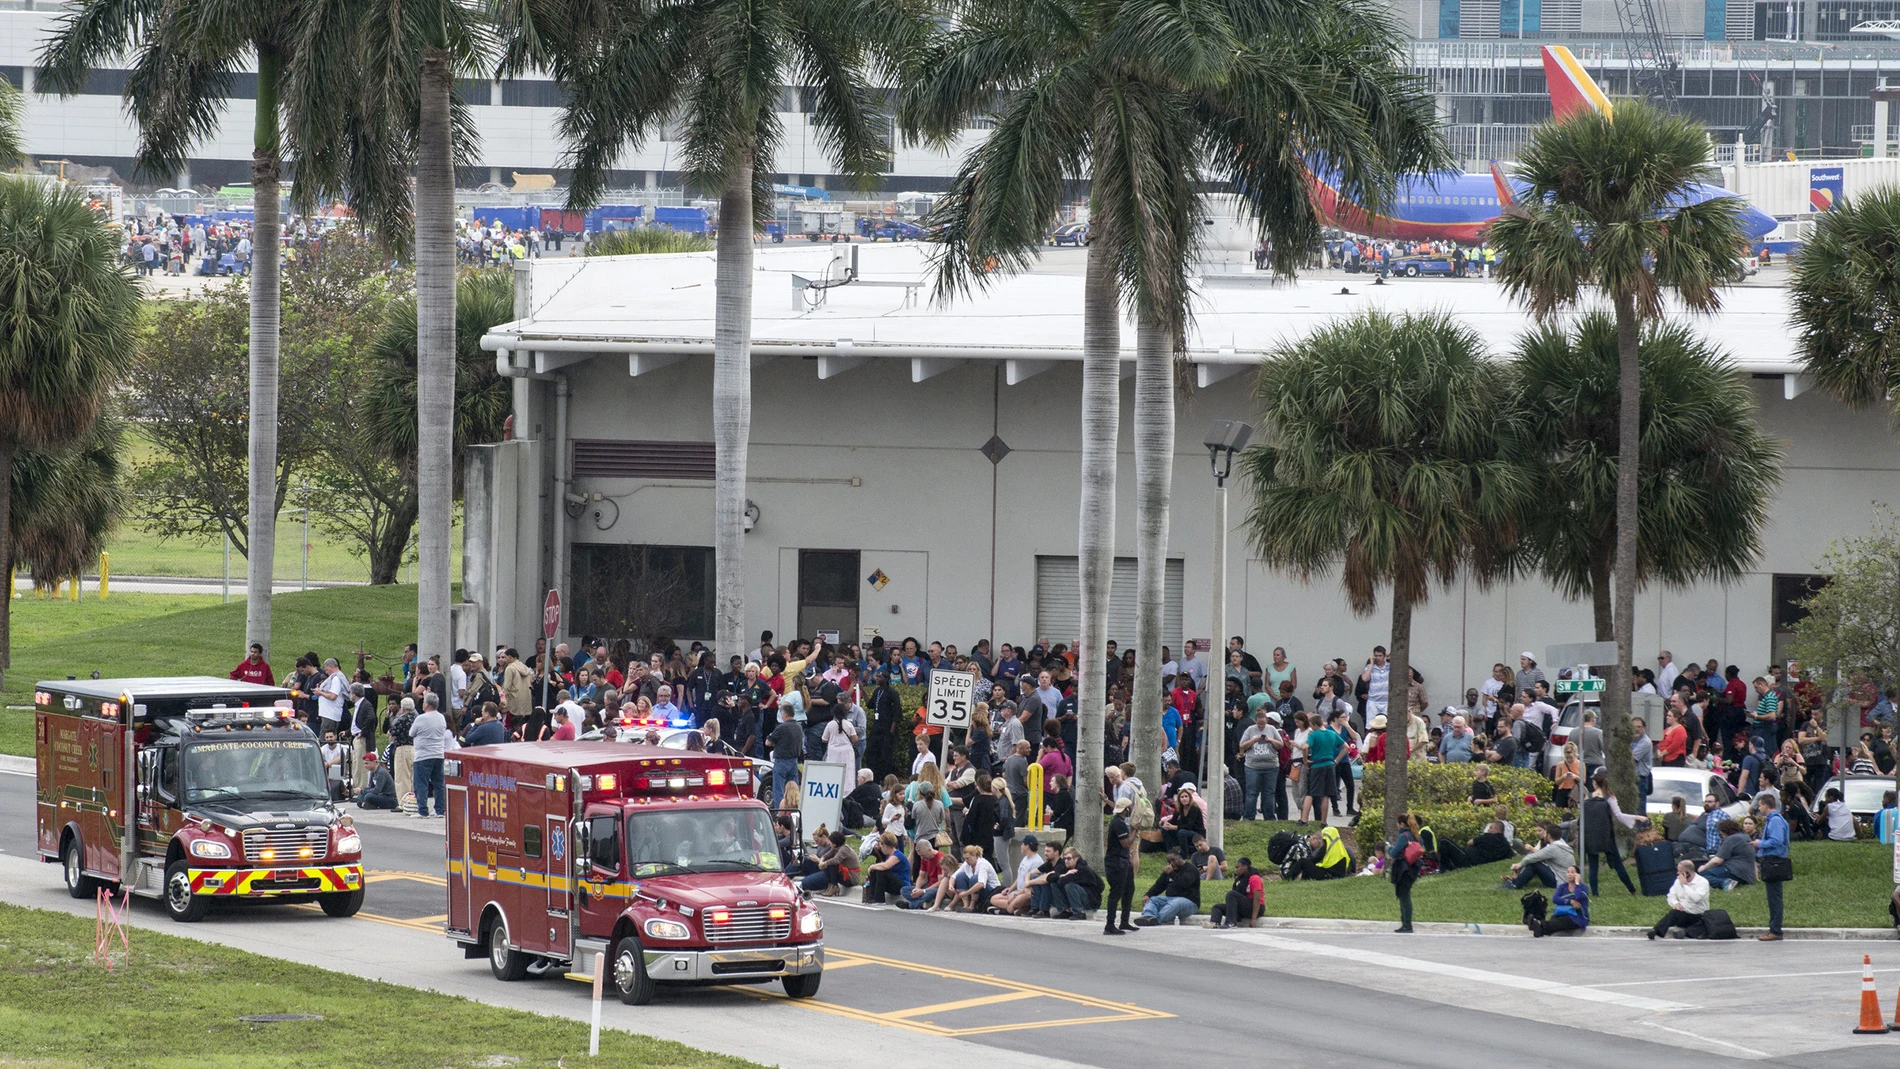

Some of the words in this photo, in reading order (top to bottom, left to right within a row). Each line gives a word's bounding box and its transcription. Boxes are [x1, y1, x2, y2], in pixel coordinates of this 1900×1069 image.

[881, 575, 887, 583] 2
[545, 605, 559, 625] STOP
[934, 676, 971, 688] SPEED
[1558, 682, 1571, 691] SW
[1577, 682, 1584, 690] 2
[1592, 681, 1603, 690] AV
[937, 688, 965, 698] LIMIT
[932, 699, 967, 720] 35
[283, 741, 308, 749] CREEK
[469, 771, 499, 789] OAKLAND
[500, 776, 517, 791] PARK
[807, 781, 839, 798] TAXI
[477, 790, 508, 818] FIRE
[481, 819, 505, 833] RESCUE
